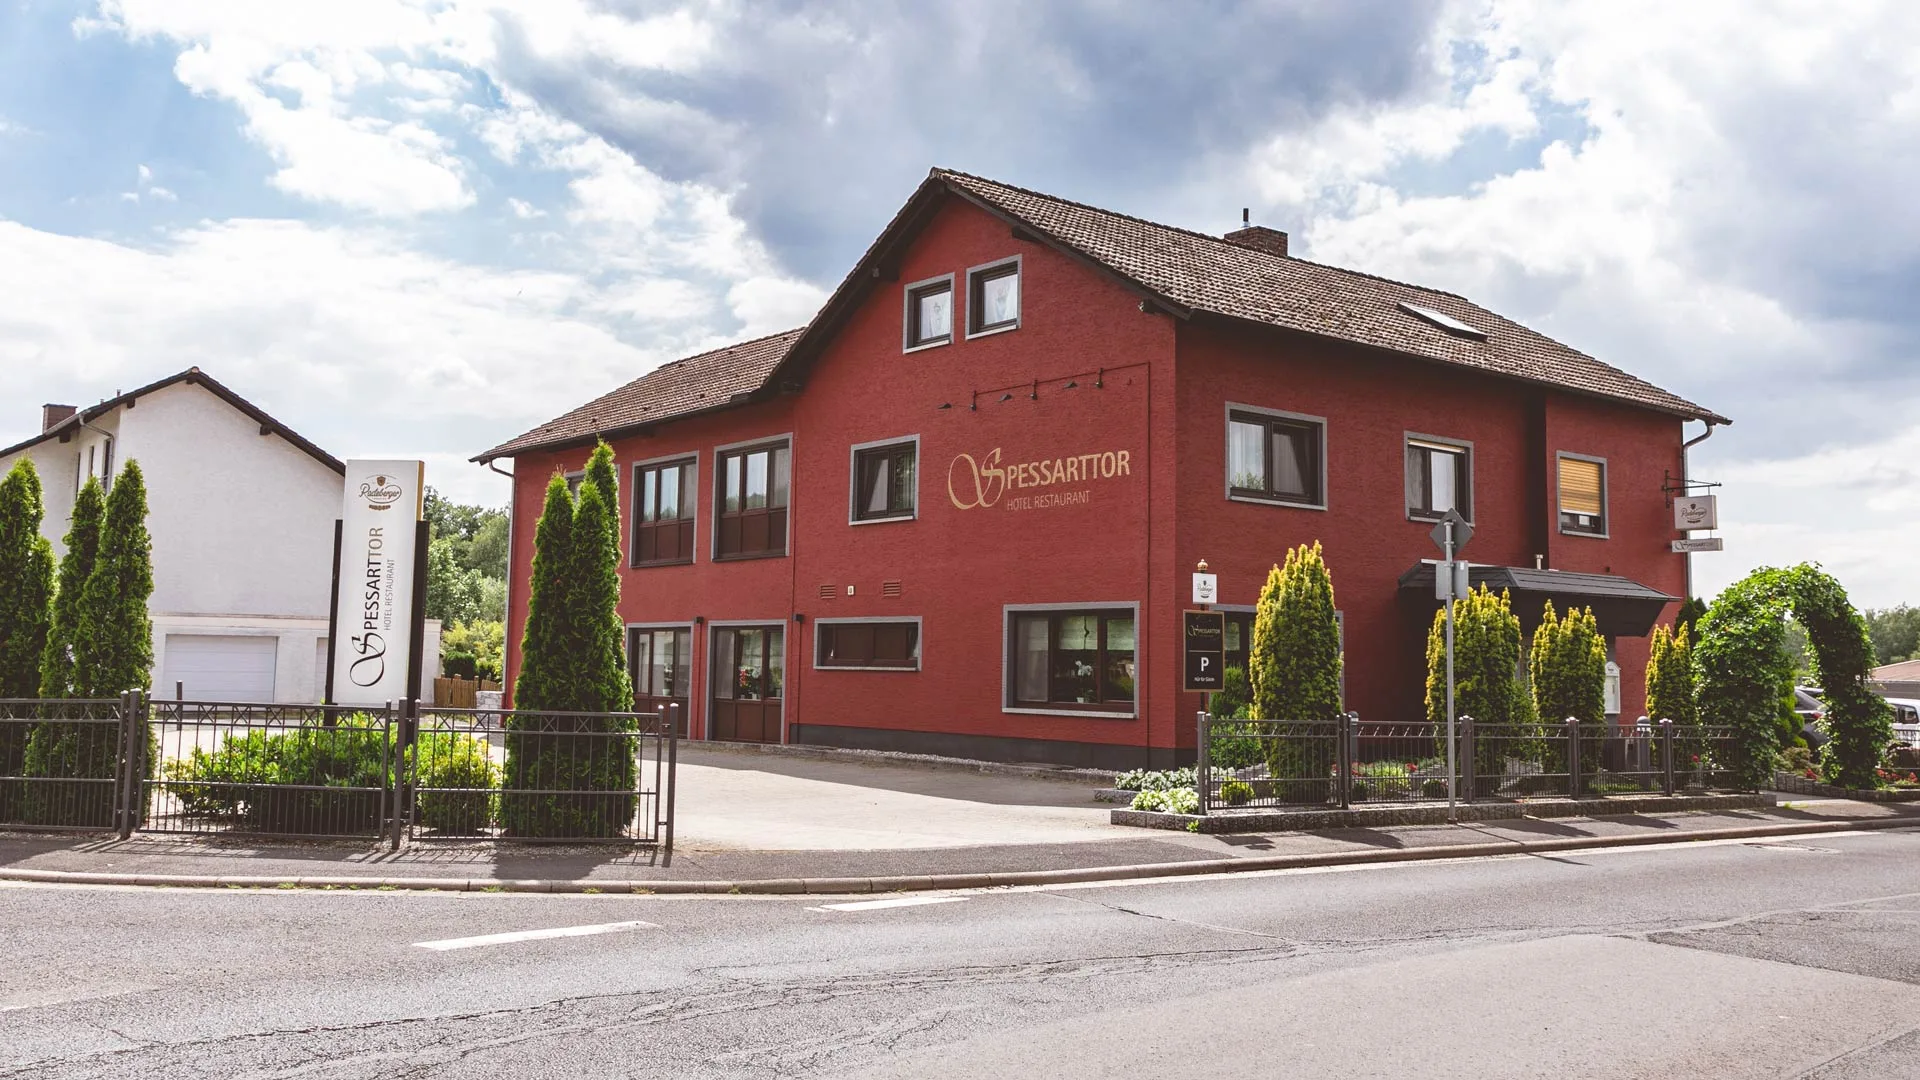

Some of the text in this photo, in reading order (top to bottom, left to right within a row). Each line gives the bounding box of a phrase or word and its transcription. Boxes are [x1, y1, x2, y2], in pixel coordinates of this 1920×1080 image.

[359, 482, 401, 500] Radeberger
[948, 447, 1131, 509] SPESSARTTOR
[1007, 490, 1090, 511] HOTEL RESTAURANT
[350, 527, 386, 687] SPESSARTTOR
[384, 559, 395, 631] HOTEL RESTAURANT
[1201, 657, 1209, 672] P
